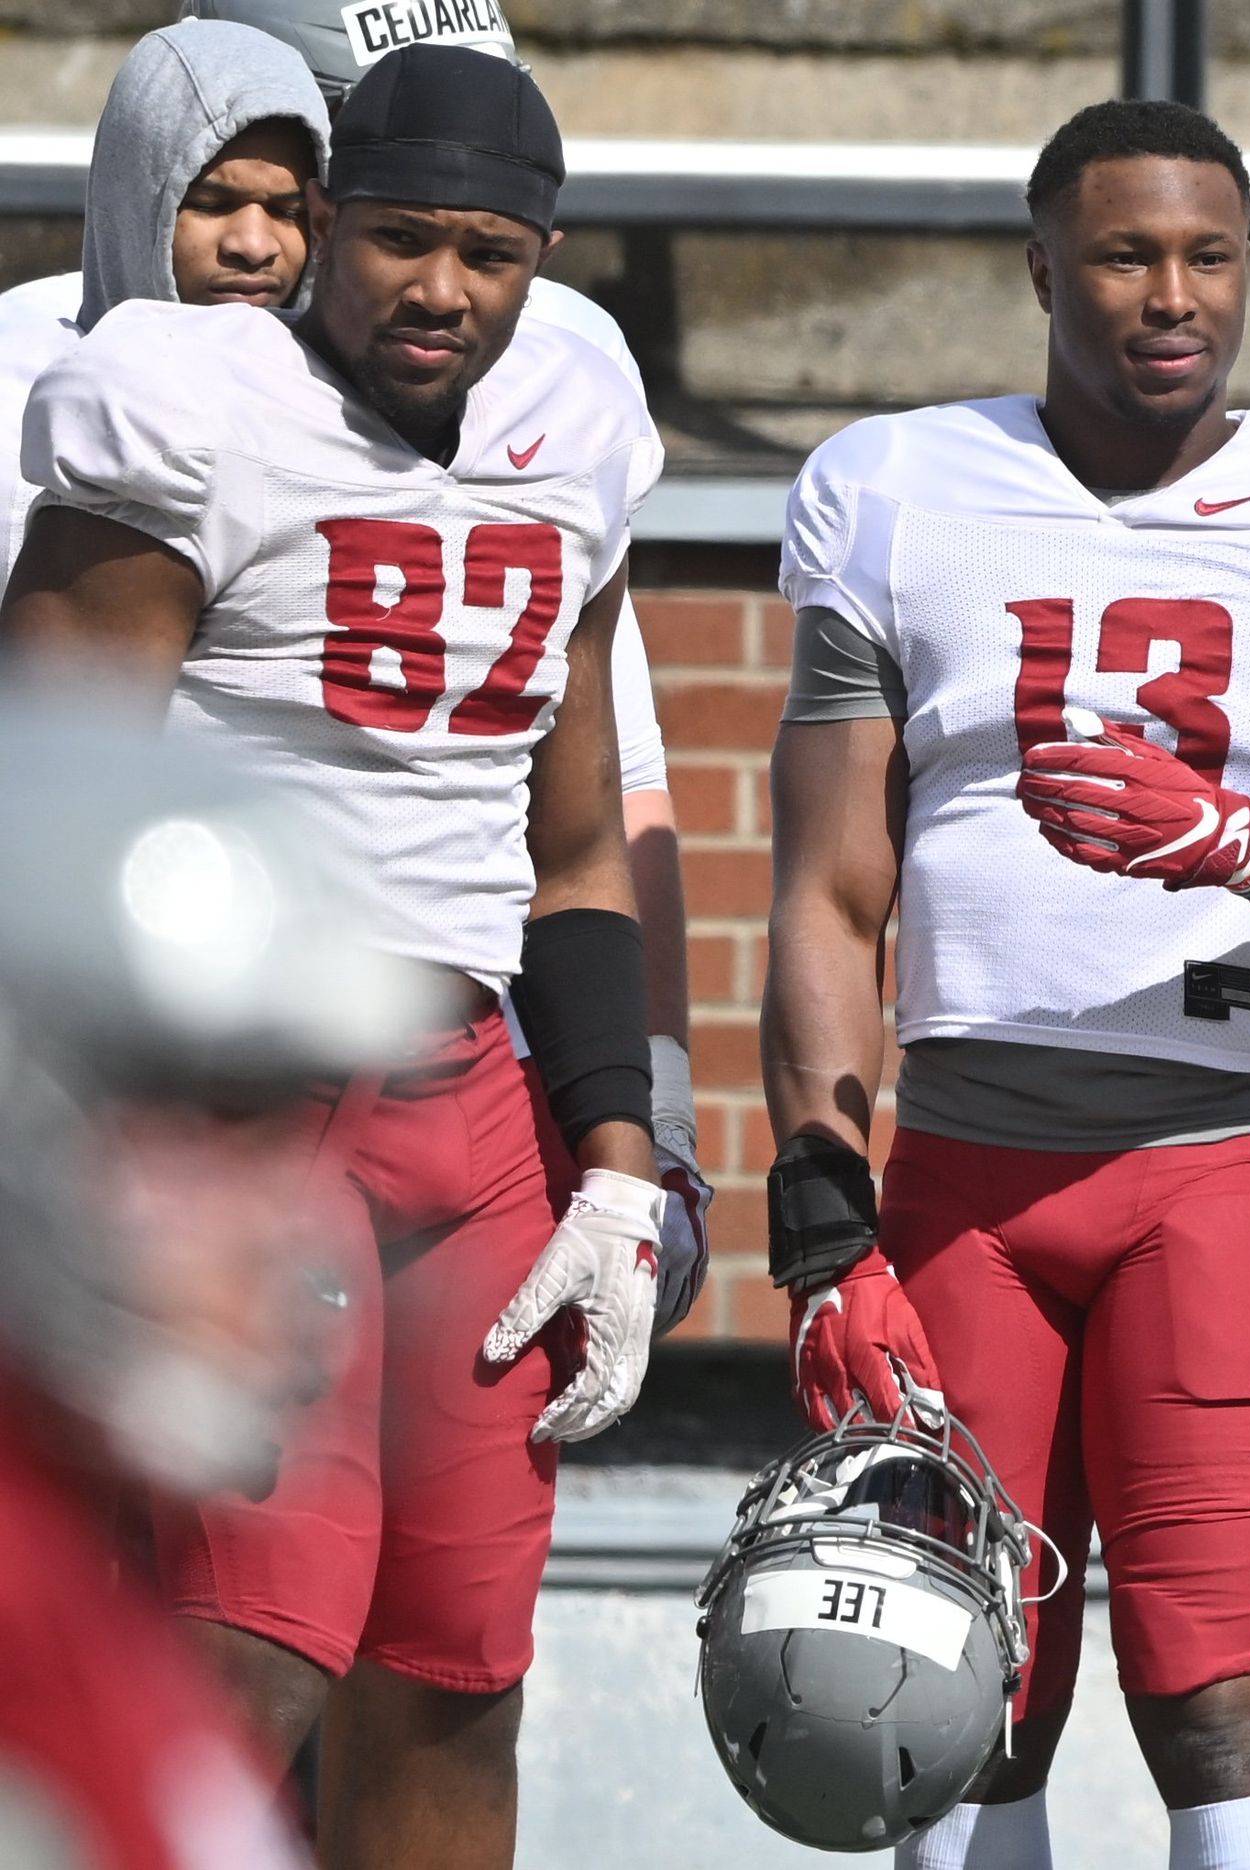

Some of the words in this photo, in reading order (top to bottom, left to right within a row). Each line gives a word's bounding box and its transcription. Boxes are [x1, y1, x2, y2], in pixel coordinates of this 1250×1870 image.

[315, 517, 563, 736] 82
[1004, 597, 1234, 789] 13
[817, 1578, 887, 1629] LEE
